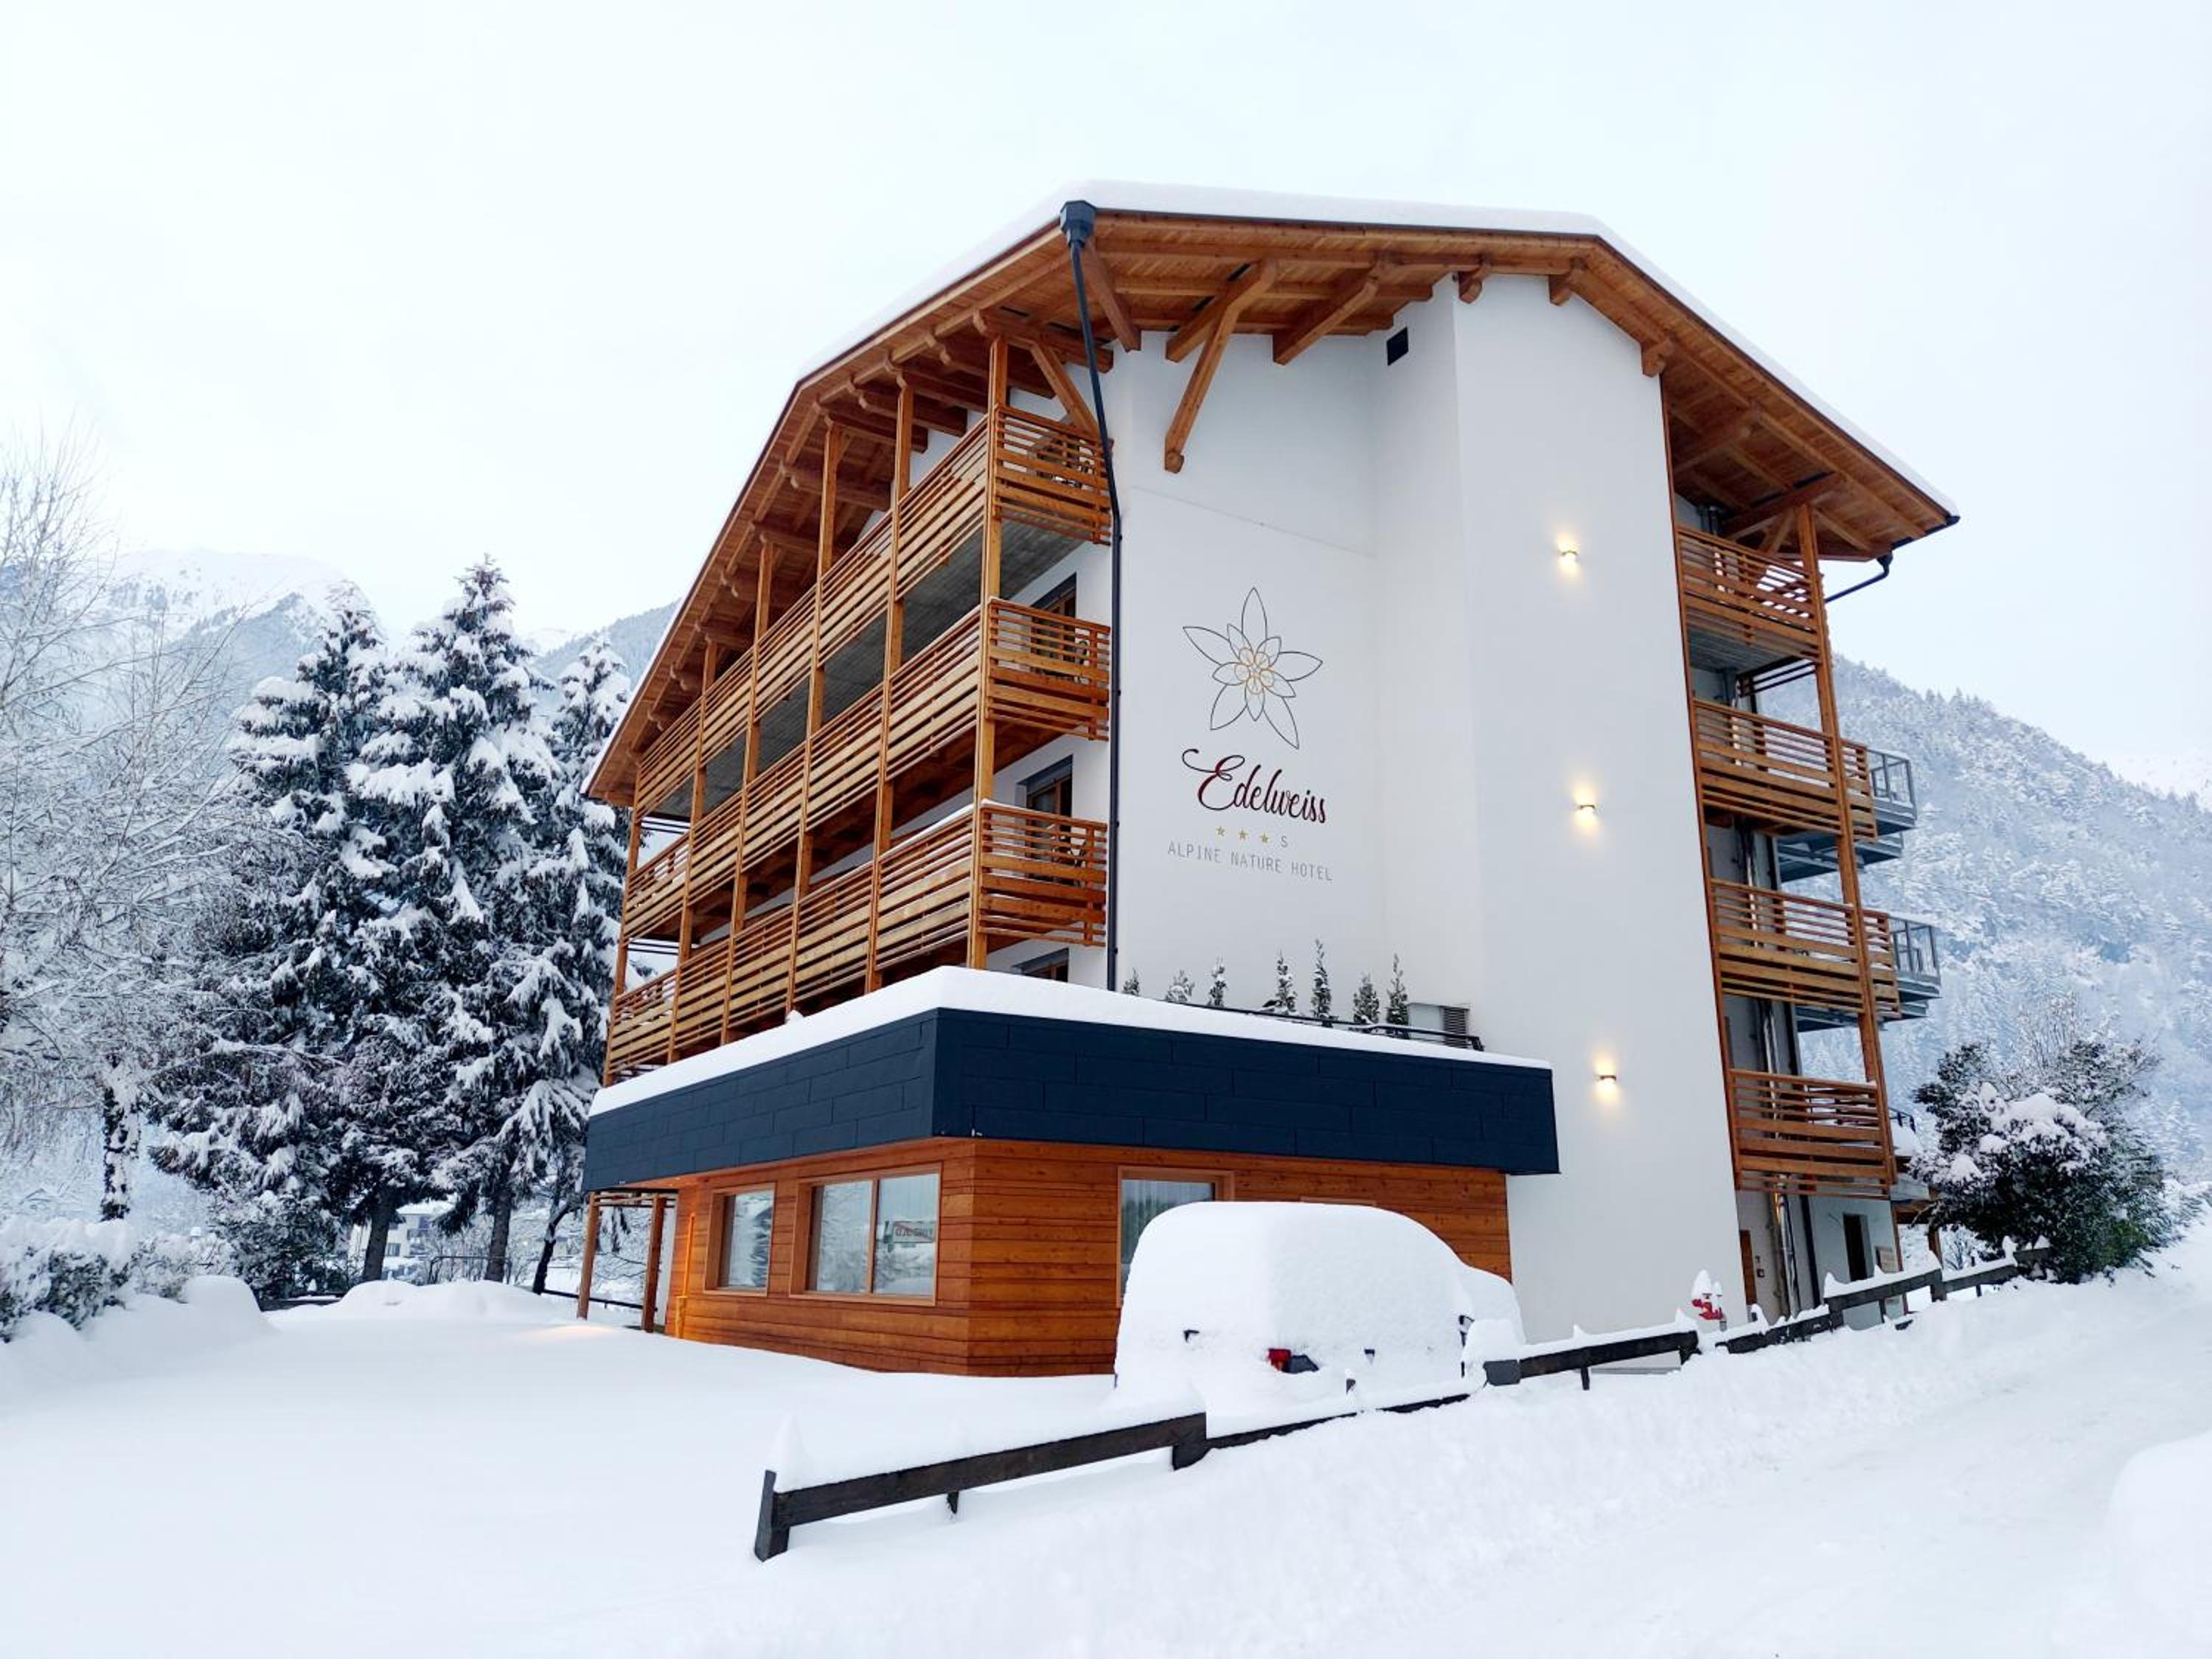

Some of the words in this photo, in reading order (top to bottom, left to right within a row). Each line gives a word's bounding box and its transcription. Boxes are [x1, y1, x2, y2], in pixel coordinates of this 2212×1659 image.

[1182, 748, 1326, 824] Edelweiss
[1168, 841, 1222, 863] ALPINE
[1231, 851, 1283, 874] NATURE
[1291, 861, 1333, 882] HOTEL
[1280, 835, 1289, 848] S
